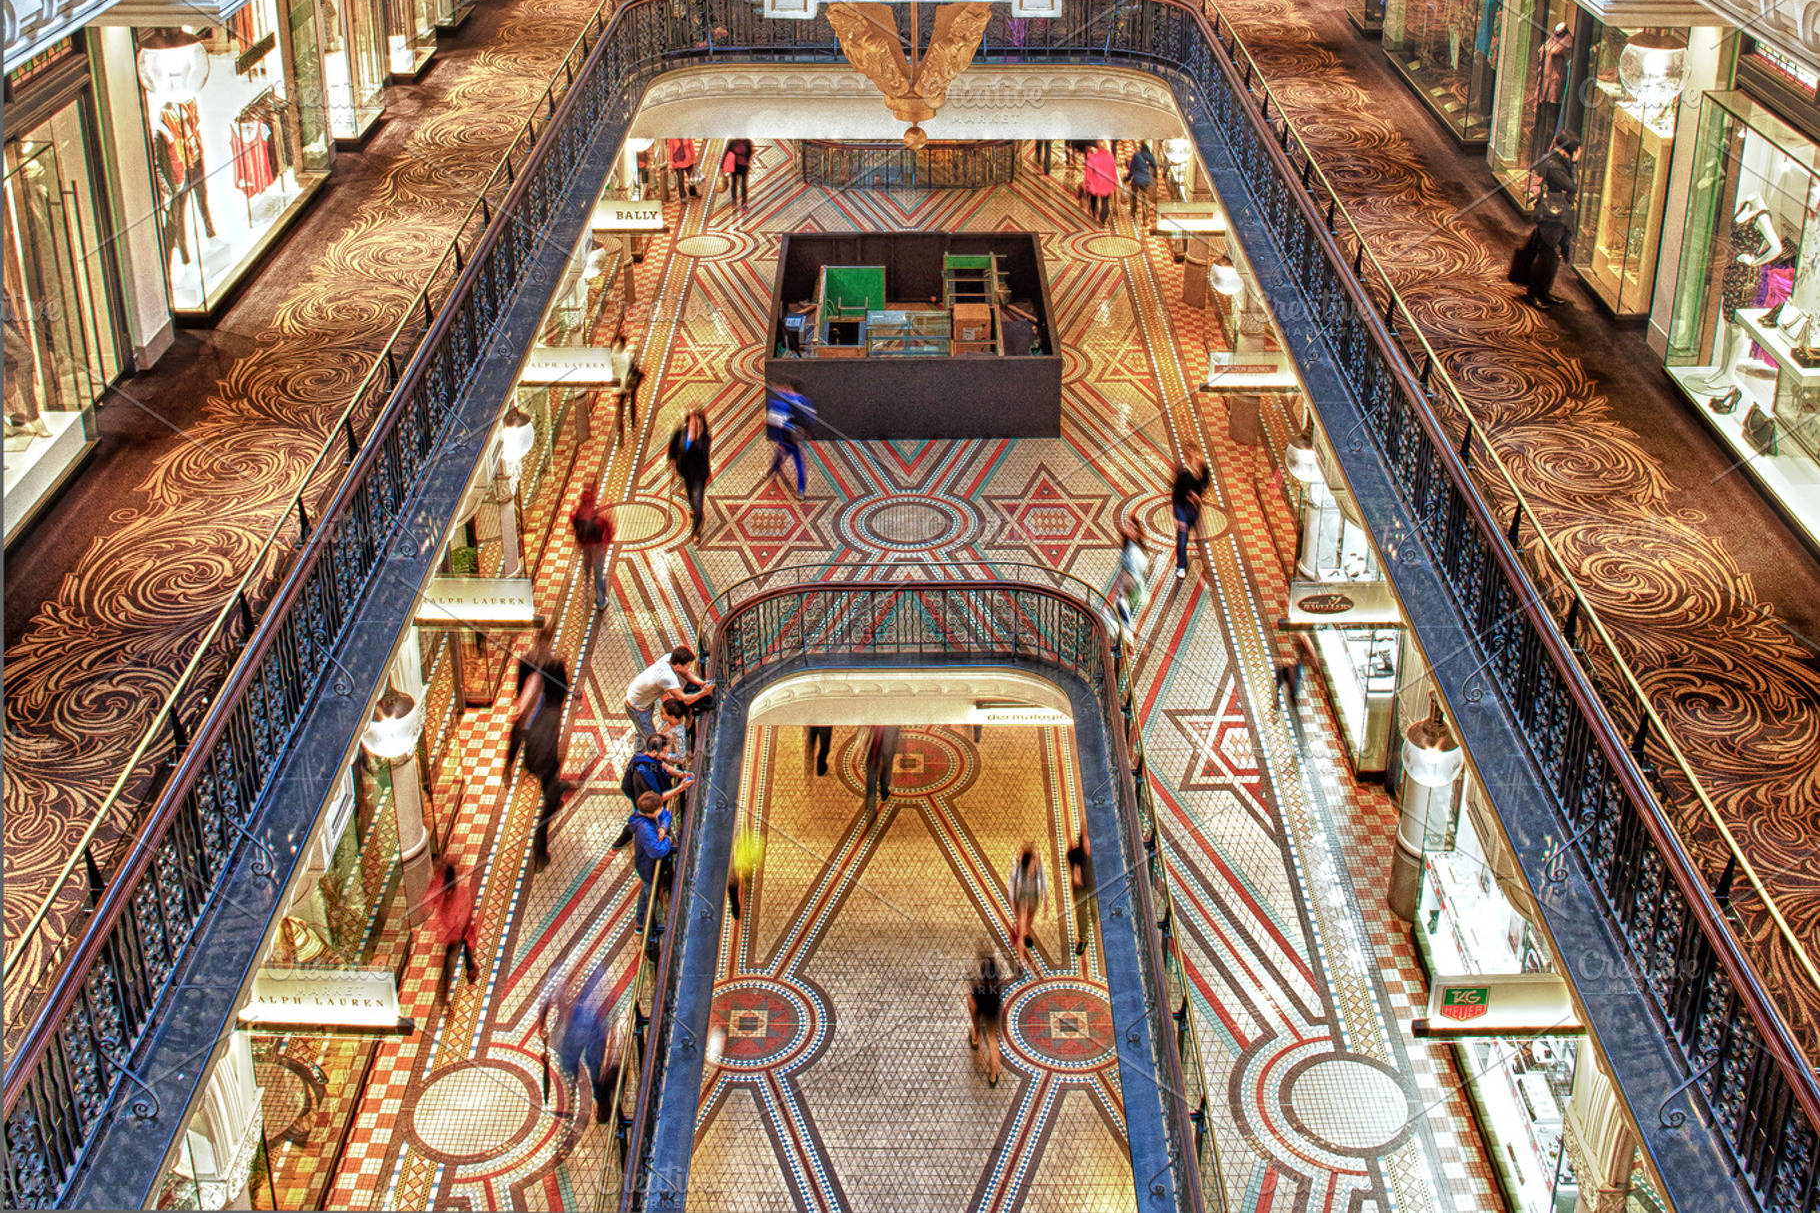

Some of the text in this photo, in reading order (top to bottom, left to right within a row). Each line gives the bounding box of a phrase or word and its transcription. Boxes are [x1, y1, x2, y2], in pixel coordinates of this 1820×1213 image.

[615, 210, 659, 220] BALLY
[473, 597, 525, 605] LAUREN
[252, 995, 386, 1007] ALPH LAUREN
[1451, 990, 1481, 1005] TAG
[1444, 1005, 1483, 1021] HEUER
